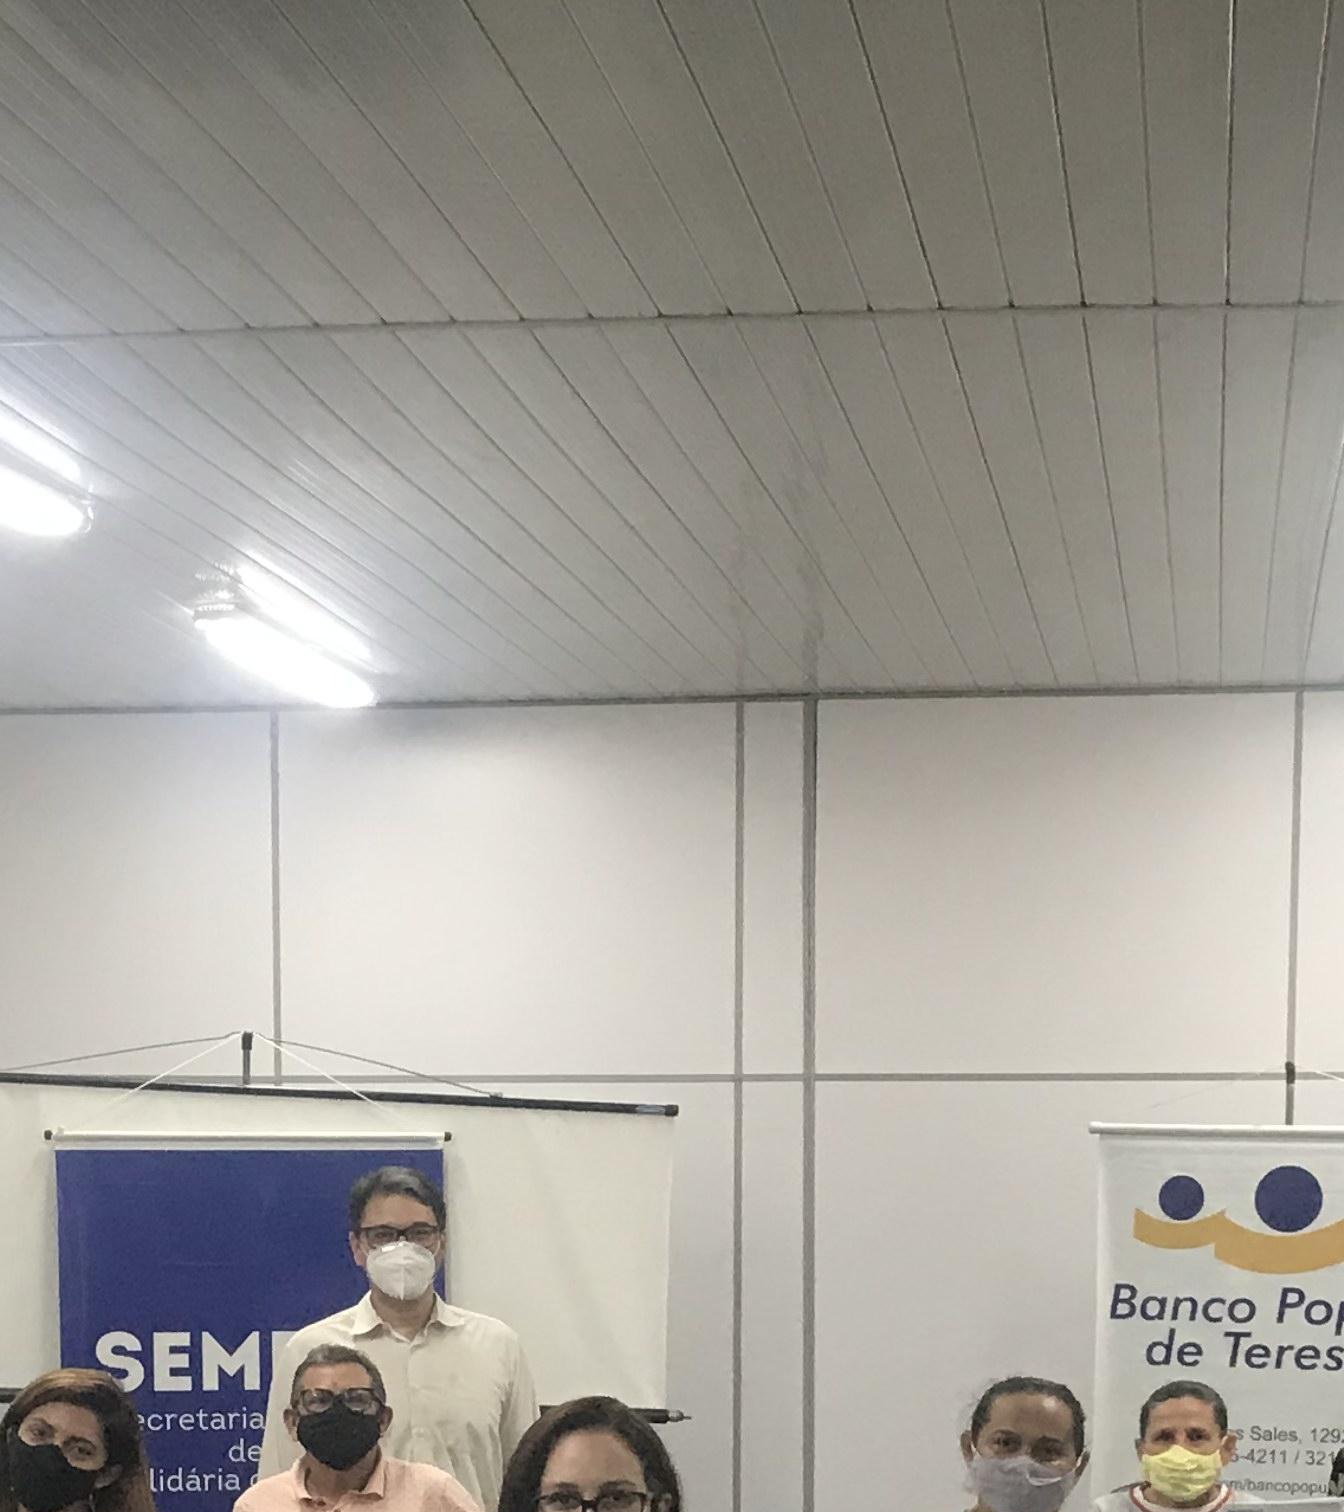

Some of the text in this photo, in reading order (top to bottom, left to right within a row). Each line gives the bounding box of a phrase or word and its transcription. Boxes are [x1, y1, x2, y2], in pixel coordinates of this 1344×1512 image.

[1109, 1283, 1256, 1324] Banco
[1145, 1328, 1203, 1367] de
[137, 1406, 266, 1432] ecretaria
[1249, 1425, 1303, 1444] Sales,
[228, 1438, 262, 1463] de
[1231, 1449, 1287, 1464] -4211
[1305, 1451, 1335, 1466] 321
[149, 1467, 241, 1493] lidária
